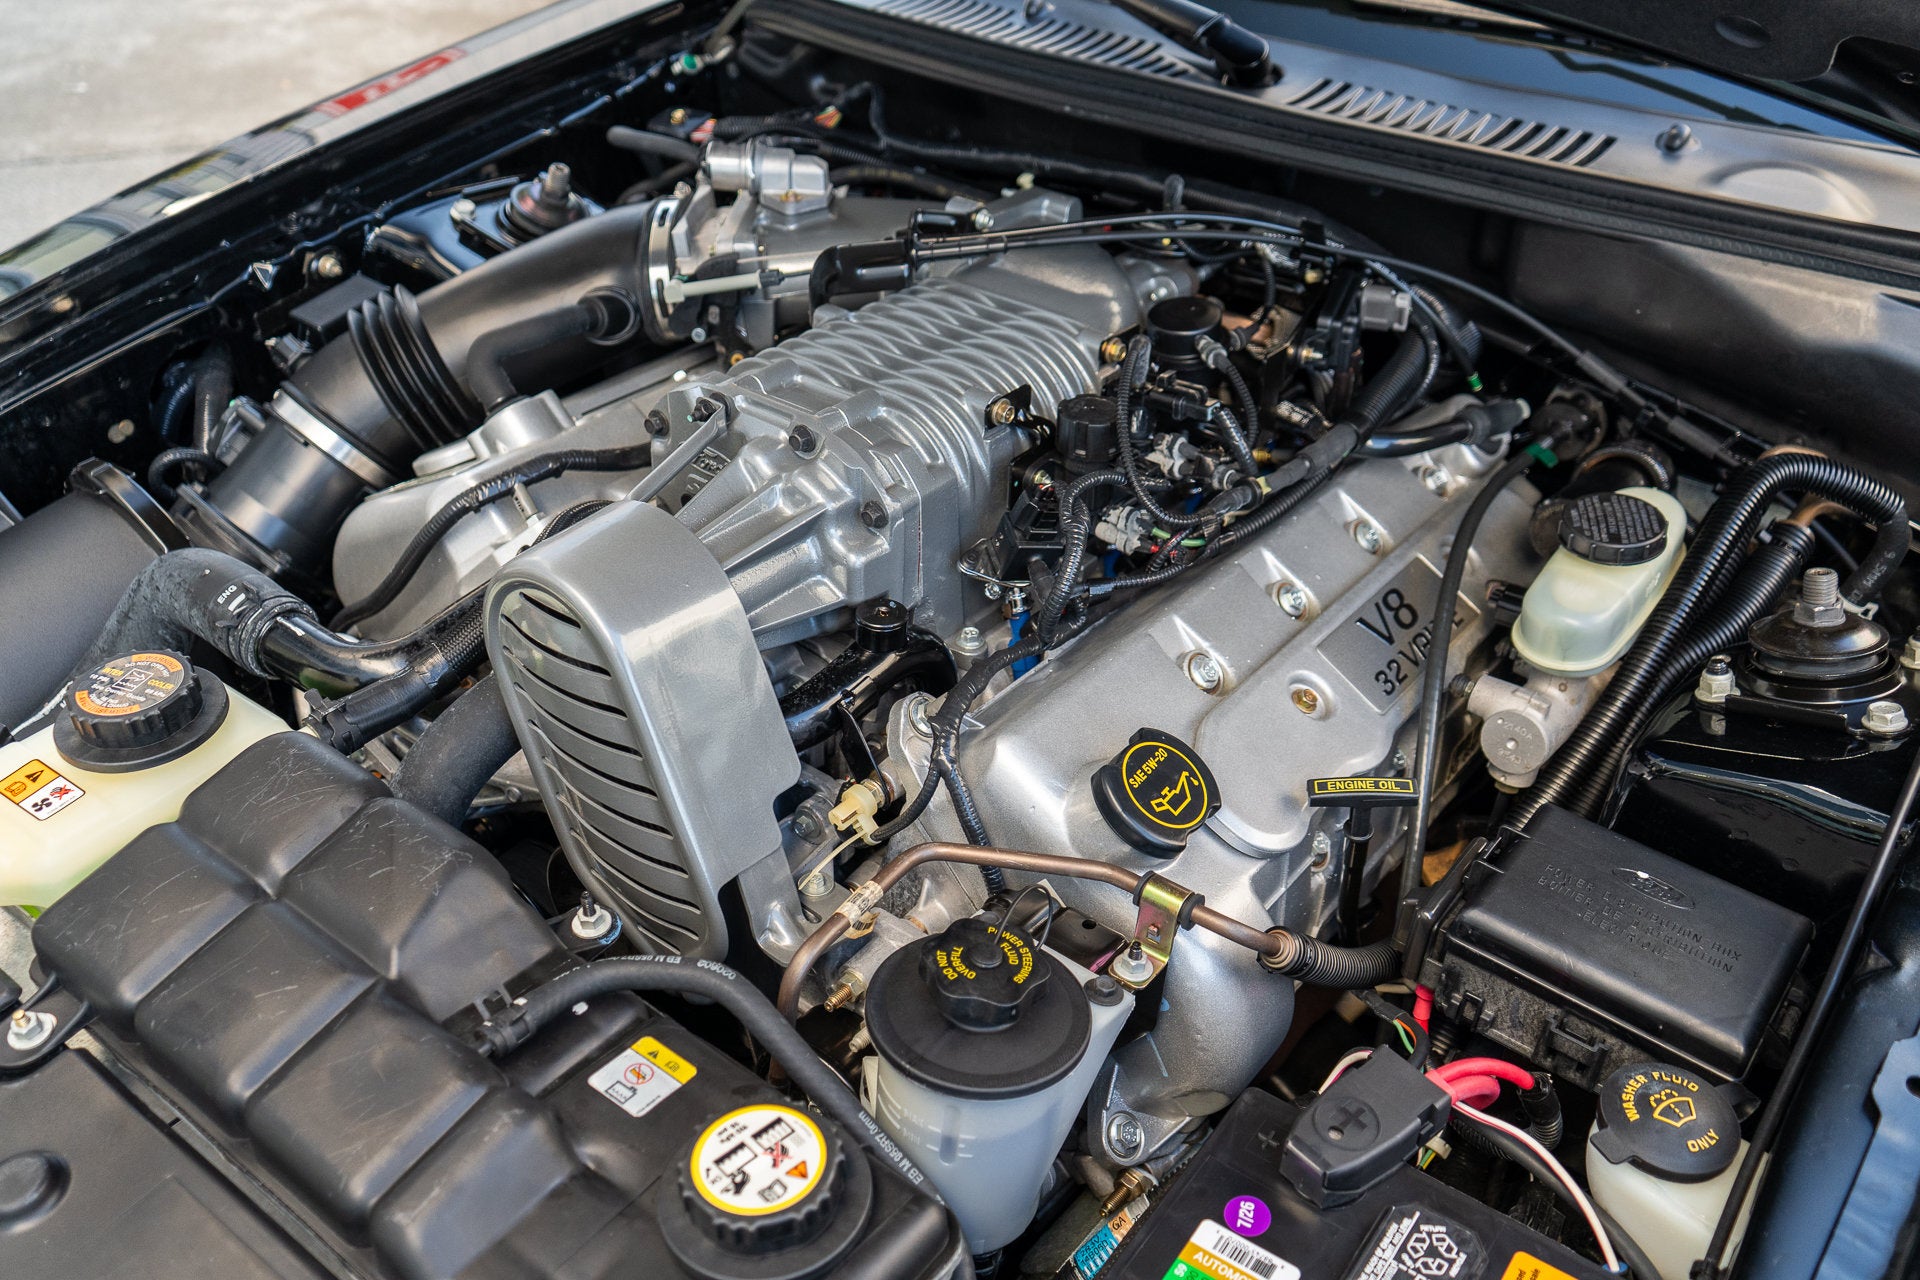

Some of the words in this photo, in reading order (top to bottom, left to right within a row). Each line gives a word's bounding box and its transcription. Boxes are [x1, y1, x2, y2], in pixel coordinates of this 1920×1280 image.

[217, 585, 237, 604] ENG
[1355, 588, 1419, 646] V8
[1375, 659, 1408, 696] 32
[1129, 769, 1148, 789] SAE
[1142, 748, 1168, 775] 5W-20
[1327, 780, 1375, 791] ENGINE
[1378, 780, 1401, 791] OIL
[1545, 864, 1595, 892] POWER
[1602, 890, 1703, 943] DISTRIBUTION
[1711, 940, 1743, 962] BOX
[1602, 906, 1623, 921] DE
[1631, 919, 1734, 973] DISTRIBUTION
[936, 950, 949, 967] NOT
[950, 946, 977, 980] OVERFILL
[987, 926, 1024, 948] PWER
[1013, 947, 1033, 984] STEERING
[1000, 942, 1019, 965] FLUID
[942, 967, 958, 980] DO
[1621, 1074, 1649, 1122] WASHER
[1651, 1071, 1699, 1092] FLUID
[1686, 1128, 1720, 1153] ONLY
[898, 1158, 912, 1172] M
[908, 1167, 924, 1185] EB
[1112, 1216, 1126, 1231] GA
[1236, 1200, 1256, 1229] 7/26
